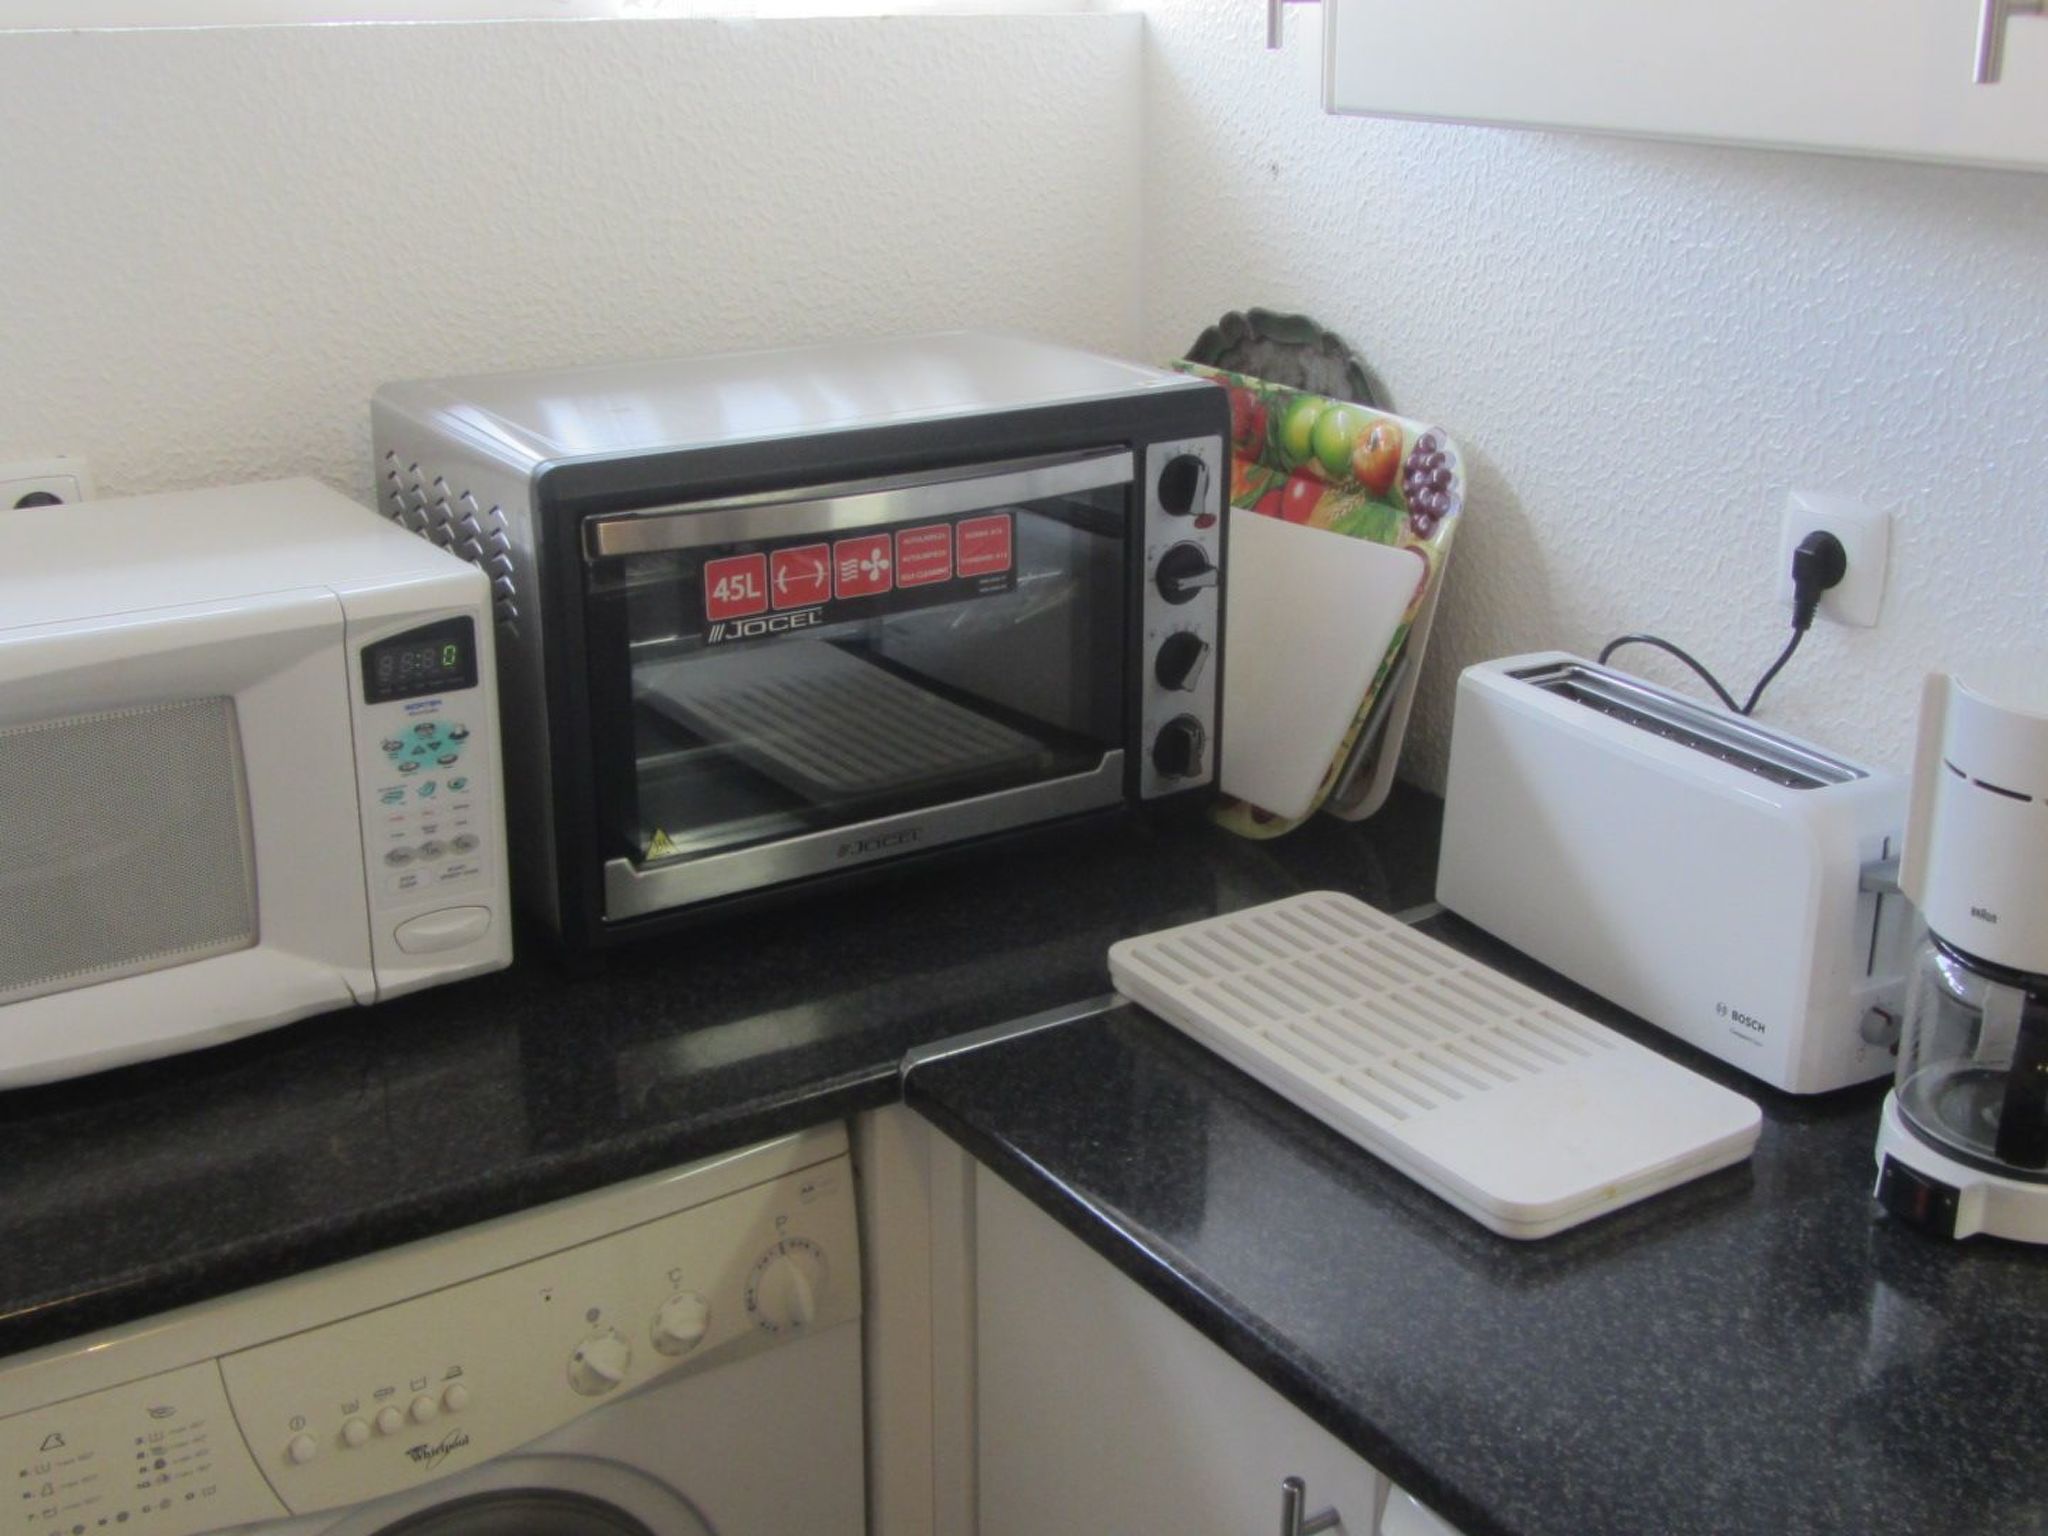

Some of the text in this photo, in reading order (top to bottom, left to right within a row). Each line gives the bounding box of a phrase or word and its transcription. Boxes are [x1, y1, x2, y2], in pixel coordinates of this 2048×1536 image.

[712, 572, 761, 602] 45L
[724, 608, 823, 640] JOCEL
[1731, 1010, 1766, 1034] BOSCH
